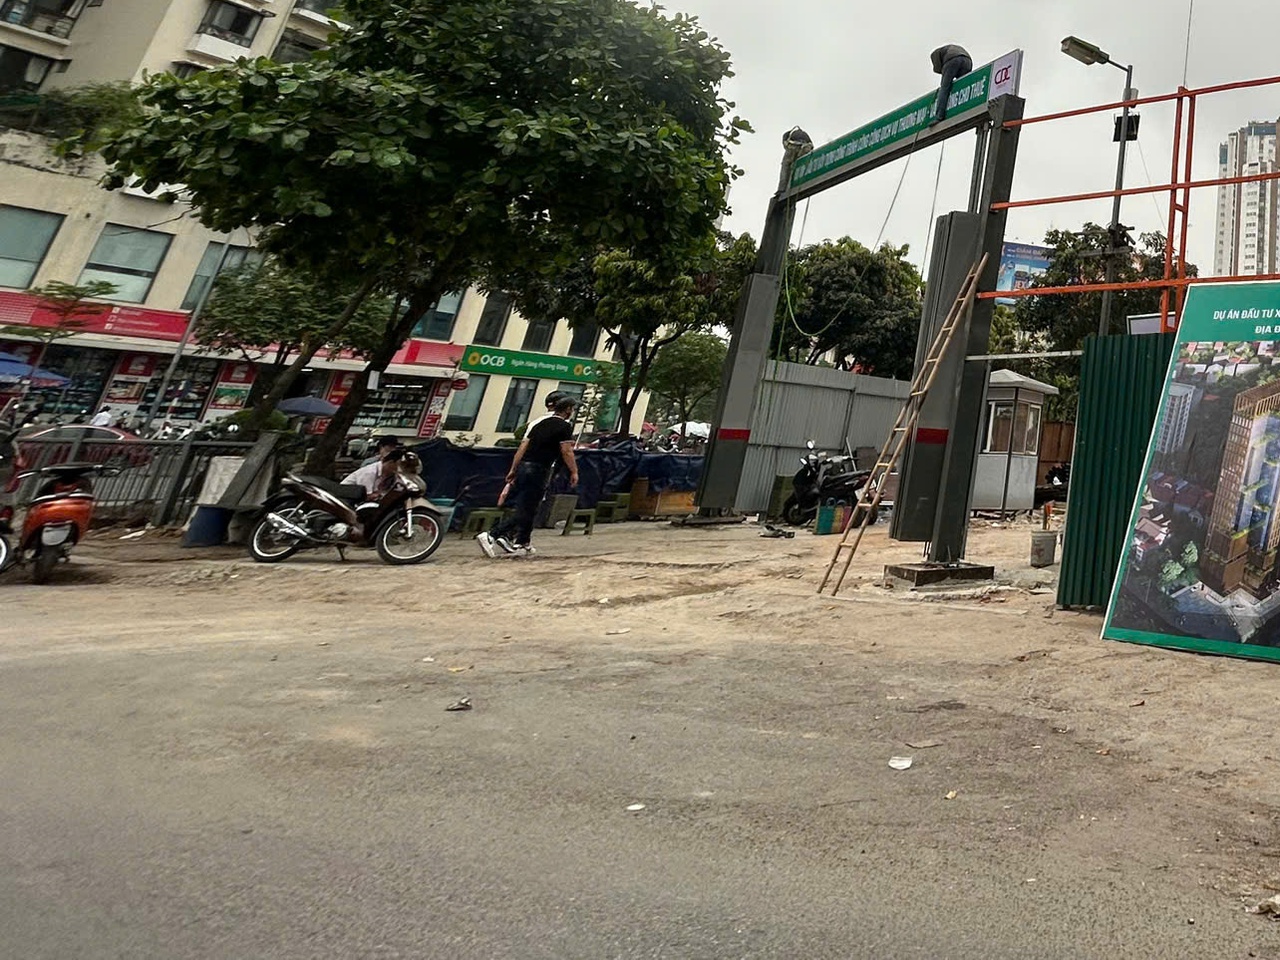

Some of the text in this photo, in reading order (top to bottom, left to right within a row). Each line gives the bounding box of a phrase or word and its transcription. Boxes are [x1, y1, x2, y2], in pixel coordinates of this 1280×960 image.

[1213, 310, 1226, 321] DỰ
[1227, 309, 1240, 319] ÁN
[1262, 309, 1274, 318] TƯ
[1255, 325, 1272, 334] ĐỊA
[480, 354, 506, 367] OCB
